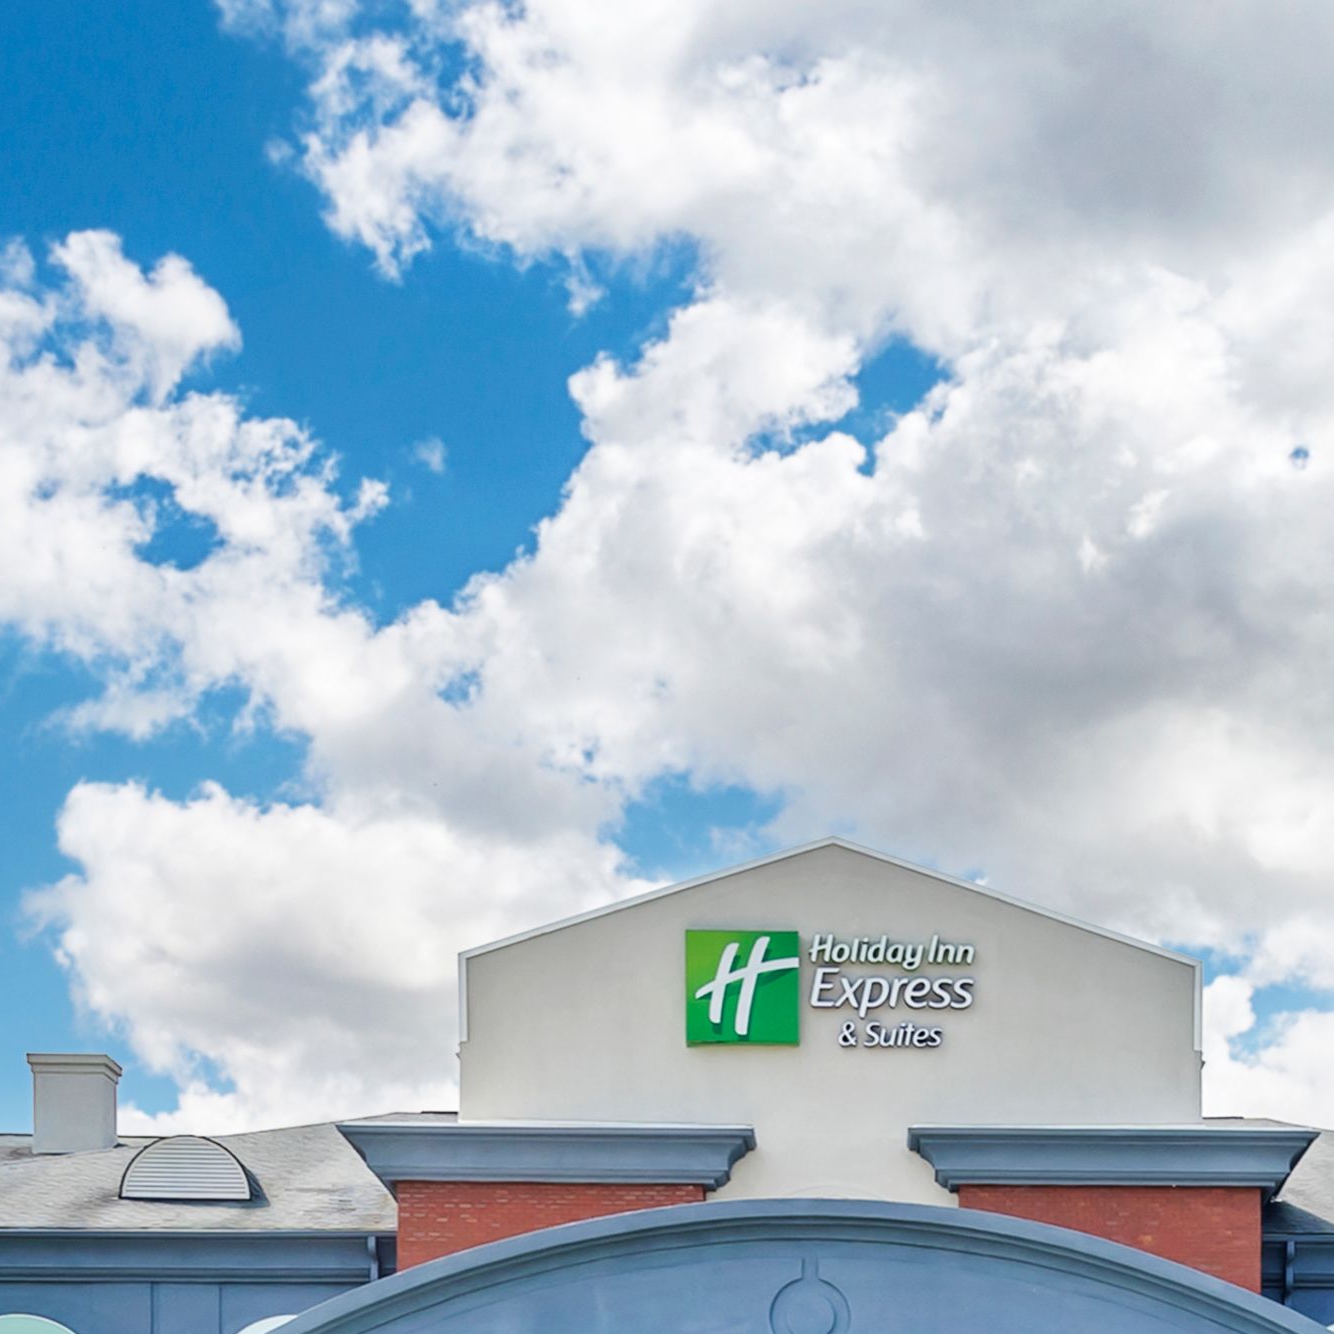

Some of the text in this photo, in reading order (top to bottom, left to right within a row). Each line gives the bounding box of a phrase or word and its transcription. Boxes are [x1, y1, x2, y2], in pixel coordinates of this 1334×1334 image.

[809, 934, 974, 969] Holiday Inn
[811, 967, 973, 1018] Express
[839, 1021, 942, 1047] & Suites
